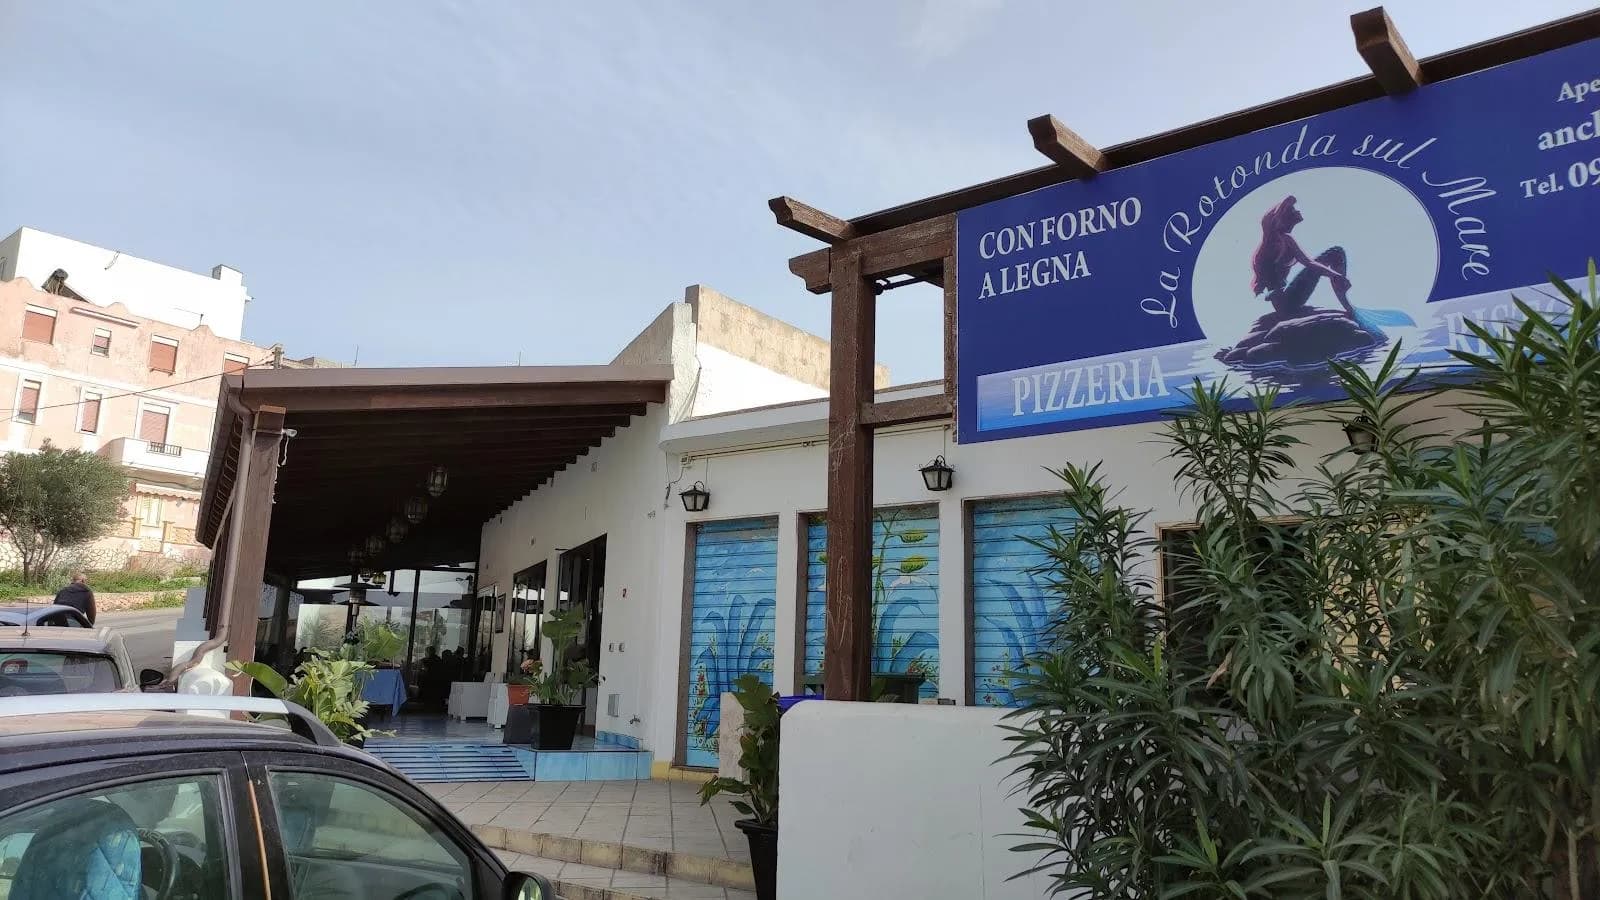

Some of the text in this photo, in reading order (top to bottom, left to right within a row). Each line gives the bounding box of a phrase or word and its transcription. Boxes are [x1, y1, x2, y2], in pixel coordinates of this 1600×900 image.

[1520, 173, 1564, 198] Tel.
[979, 197, 1142, 260] CON FORNO
[1140, 124, 1497, 328] La Rotonda sul Mare
[978, 251, 1092, 300] A LEGNA
[1012, 355, 1170, 417] PIZZERIA
